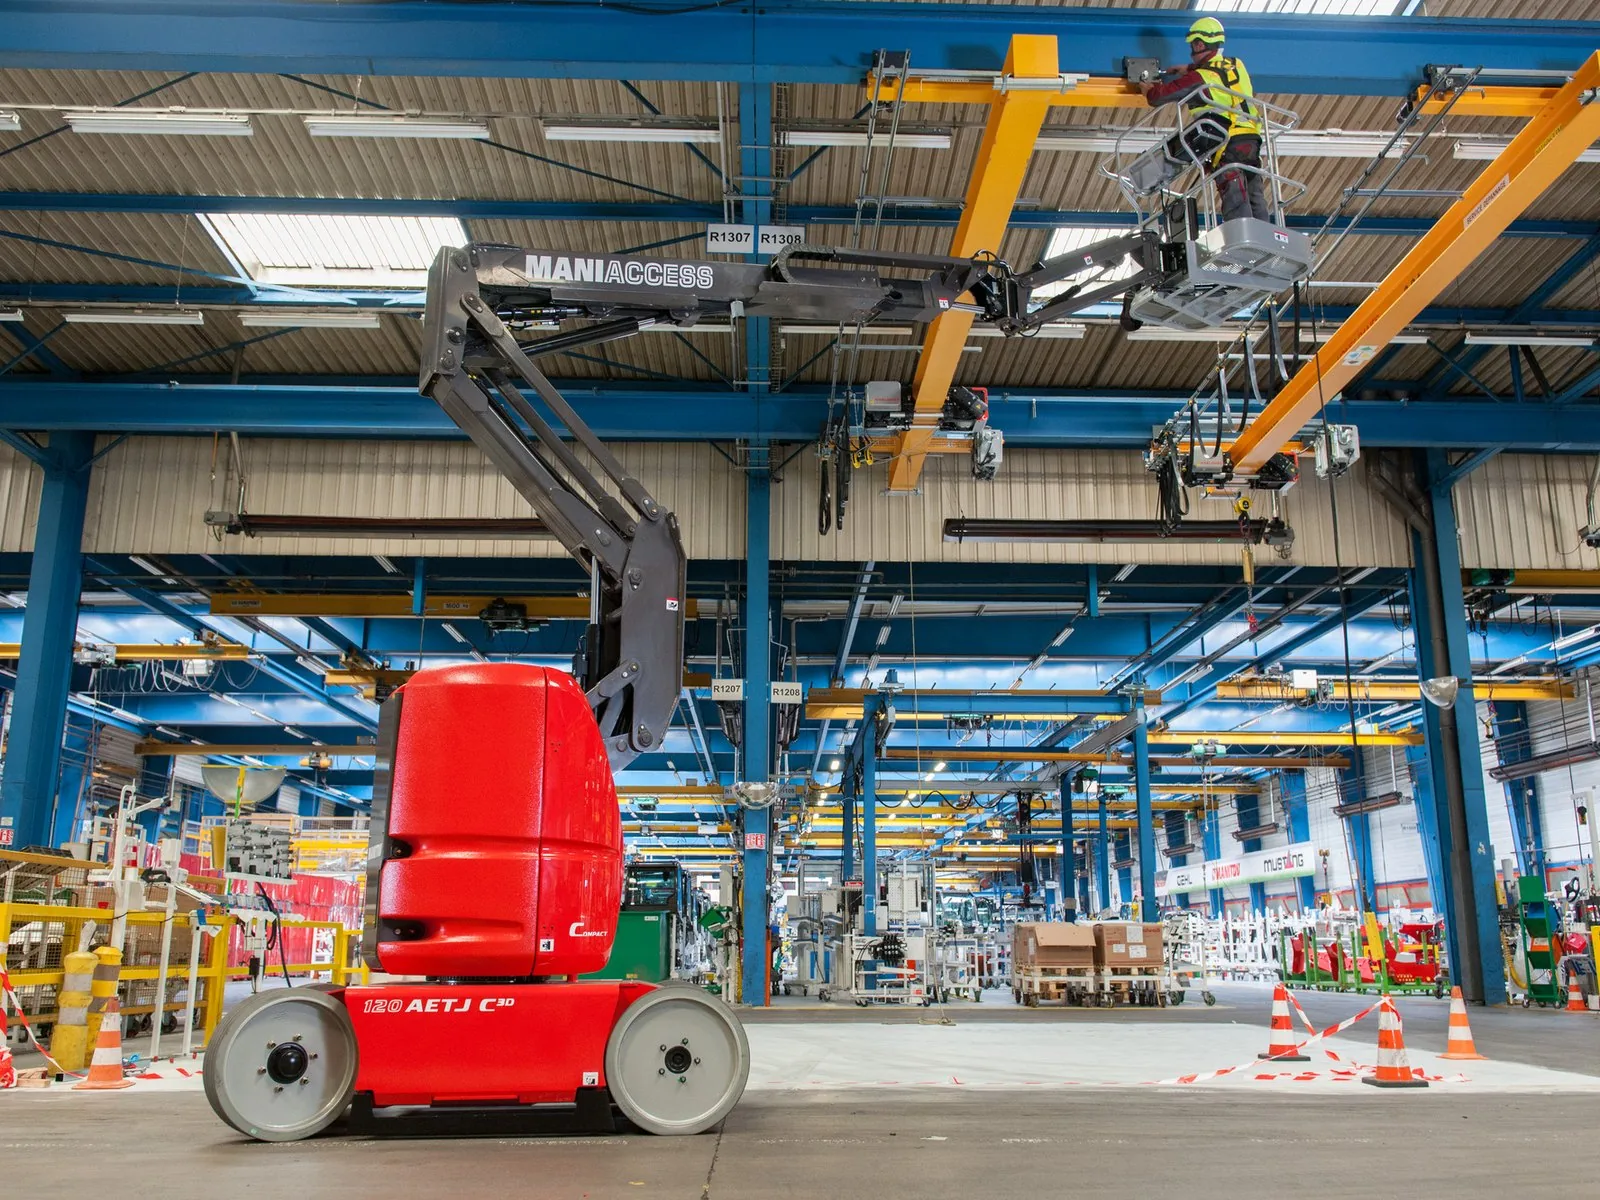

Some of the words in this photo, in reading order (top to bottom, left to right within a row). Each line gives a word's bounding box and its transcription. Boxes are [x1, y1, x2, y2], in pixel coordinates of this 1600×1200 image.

[710, 232, 751, 243] R1307
[760, 233, 802, 245] R1308
[525, 254, 714, 290] MANIACCESS
[713, 685, 741, 693] R1207
[772, 688, 800, 696] R1208
[363, 999, 403, 1013] 120
[405, 998, 472, 1013] AETJ
